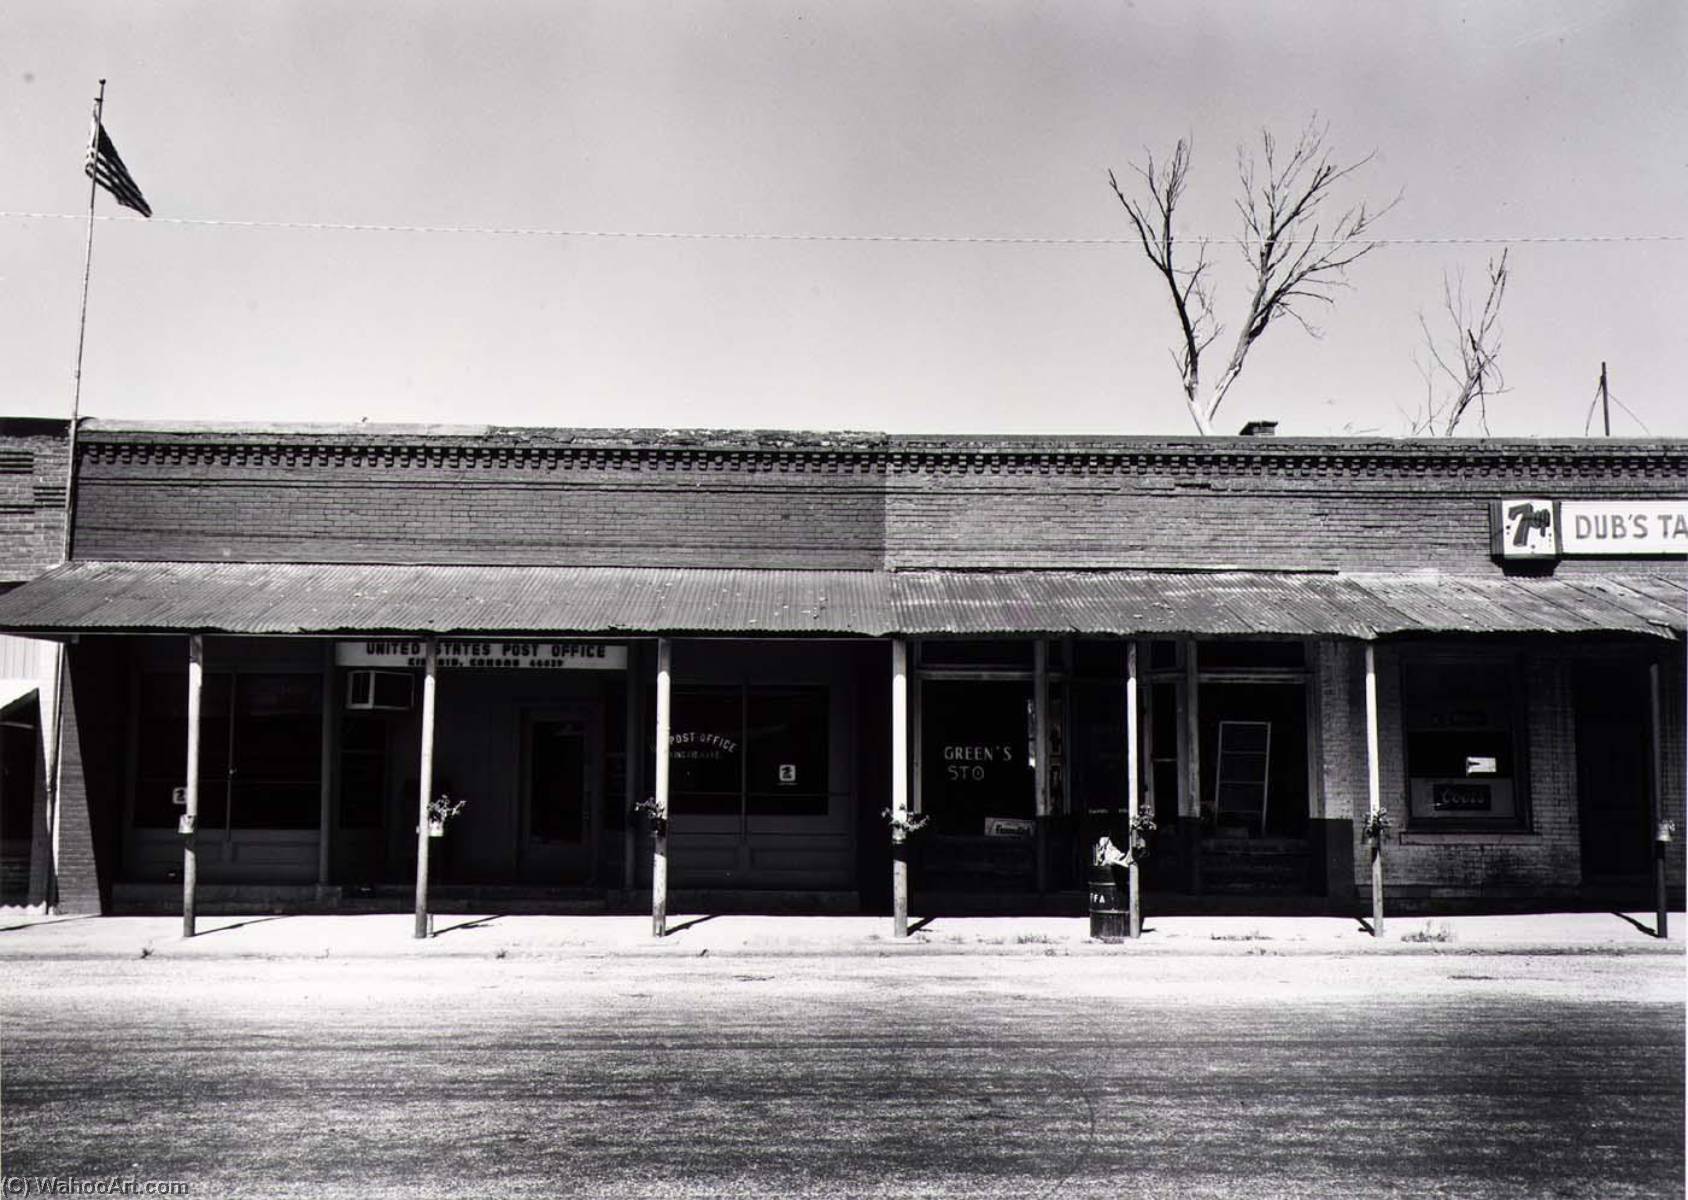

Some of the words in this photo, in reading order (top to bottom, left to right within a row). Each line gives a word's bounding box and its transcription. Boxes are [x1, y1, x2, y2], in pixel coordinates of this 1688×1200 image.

[1576, 514, 1648, 539] DUB'S
[366, 642, 420, 656] UNITED
[436, 643, 490, 657] STATES
[503, 643, 540, 657] POST
[552, 644, 606, 658] OFFICE
[669, 732, 695, 745] POST
[699, 733, 737, 752] OFFICE
[944, 746, 1013, 761] GREEN'S
[947, 765, 985, 781] STO
